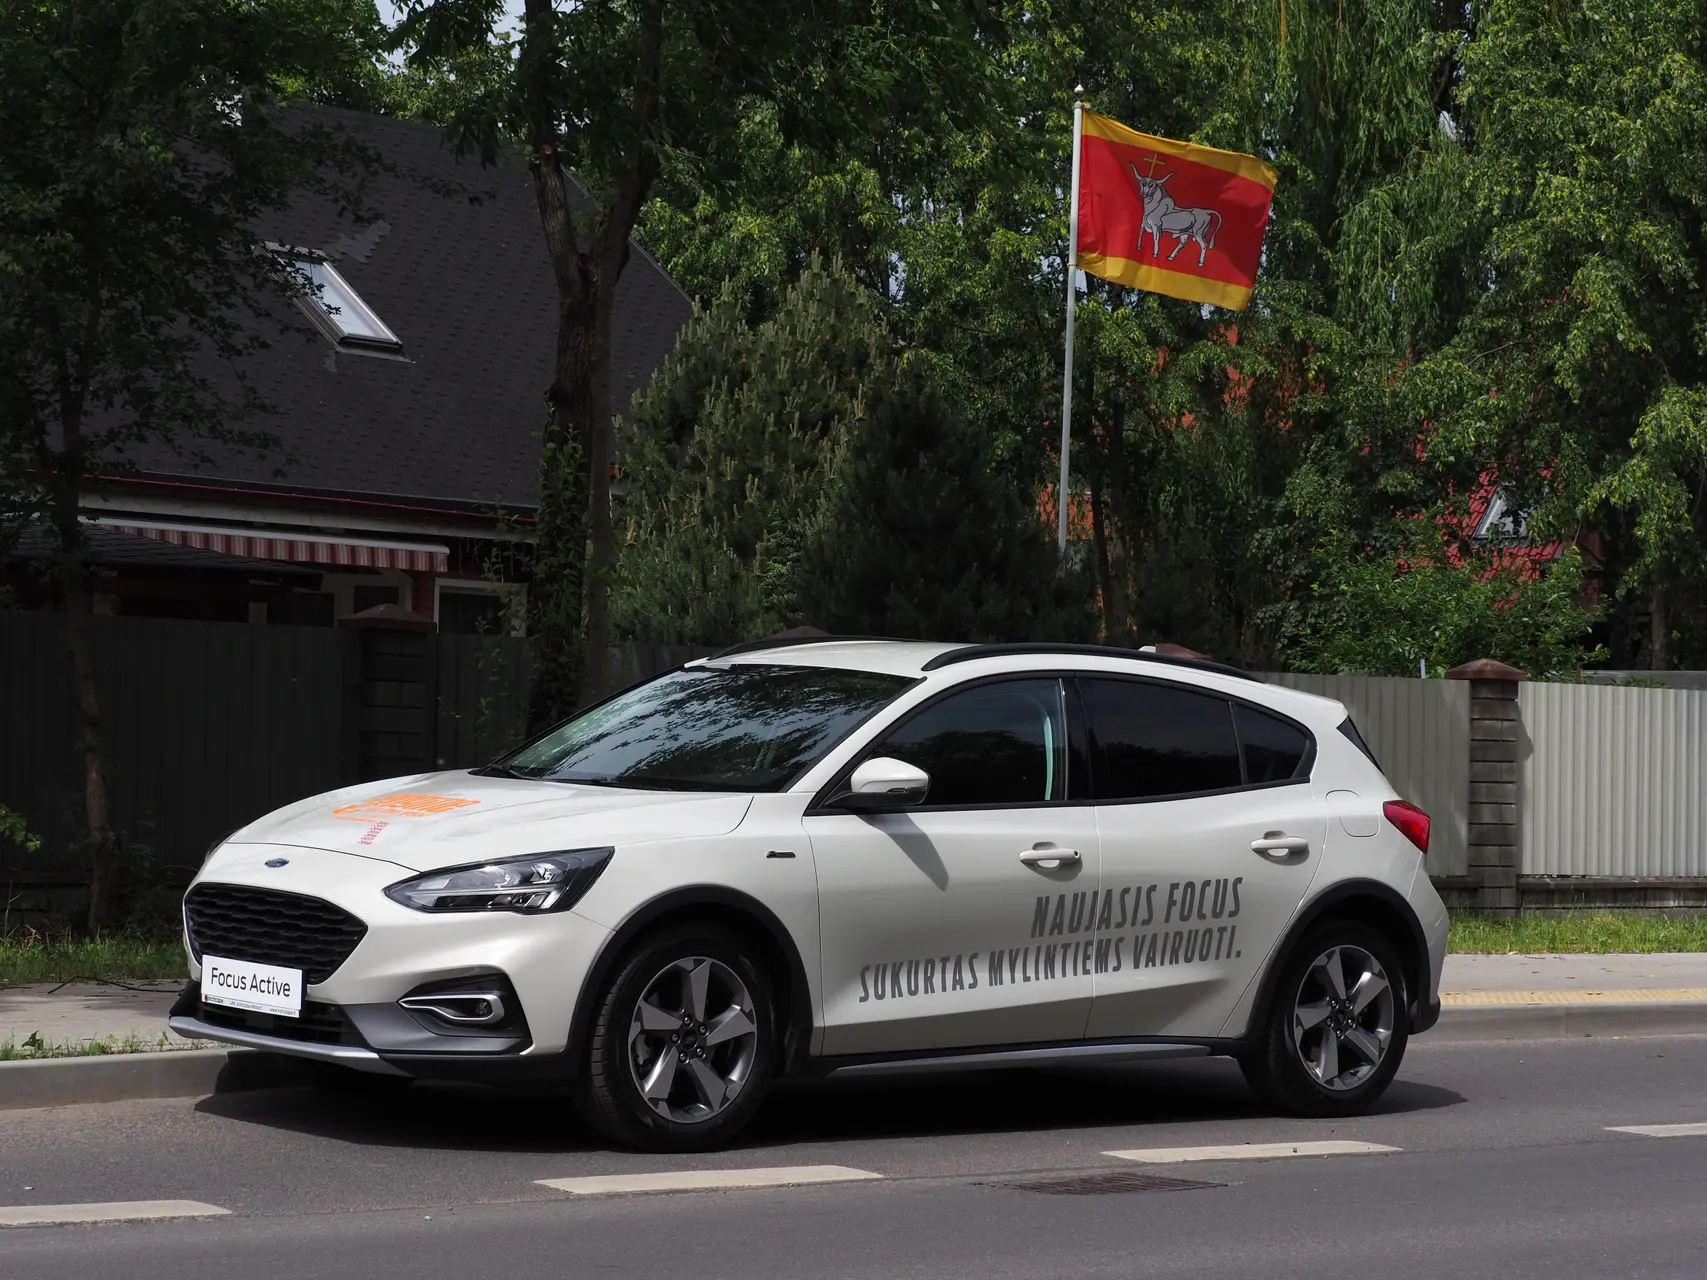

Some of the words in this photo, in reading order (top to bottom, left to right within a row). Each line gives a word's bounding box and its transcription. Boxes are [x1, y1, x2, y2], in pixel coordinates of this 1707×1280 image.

[1030, 884, 1157, 938] NAUJASIS
[1164, 877, 1243, 923] FOCUS
[211, 967, 247, 990] Focus
[249, 974, 291, 997] Active
[859, 952, 978, 1003] SUKURTAS
[988, 937, 1124, 987] MYLINTIEMS
[1132, 925, 1242, 970] VAIRUOTI.
